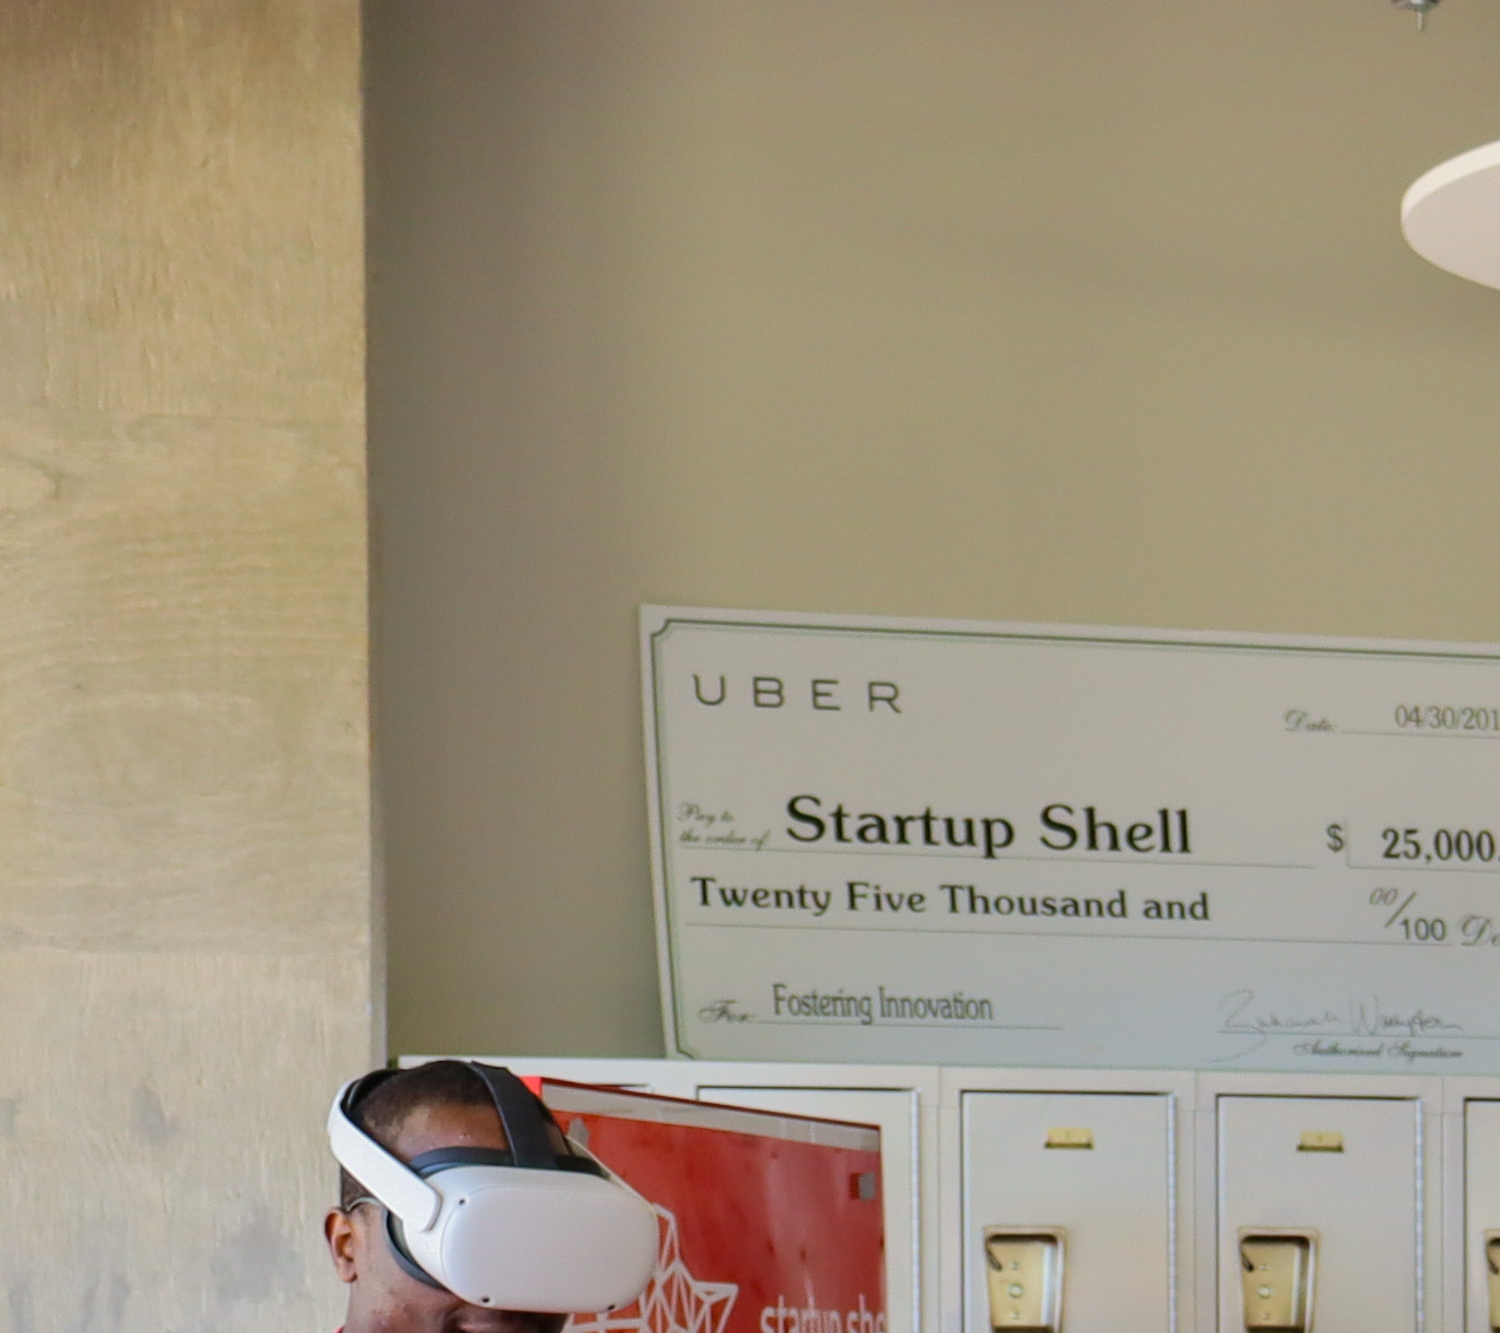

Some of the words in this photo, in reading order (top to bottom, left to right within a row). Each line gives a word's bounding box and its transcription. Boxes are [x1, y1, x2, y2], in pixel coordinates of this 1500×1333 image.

[693, 674, 902, 714] UBER
[786, 794, 1015, 859] Startup
[1039, 802, 1192, 854] Shell
[1326, 822, 1345, 854] $
[690, 876, 833, 916] Twenty
[846, 881, 927, 912] Five
[939, 884, 1128, 918] Thousand
[1142, 891, 1211, 921] and
[771, 982, 873, 1025] Fostering
[878, 985, 994, 1020] Innovation
